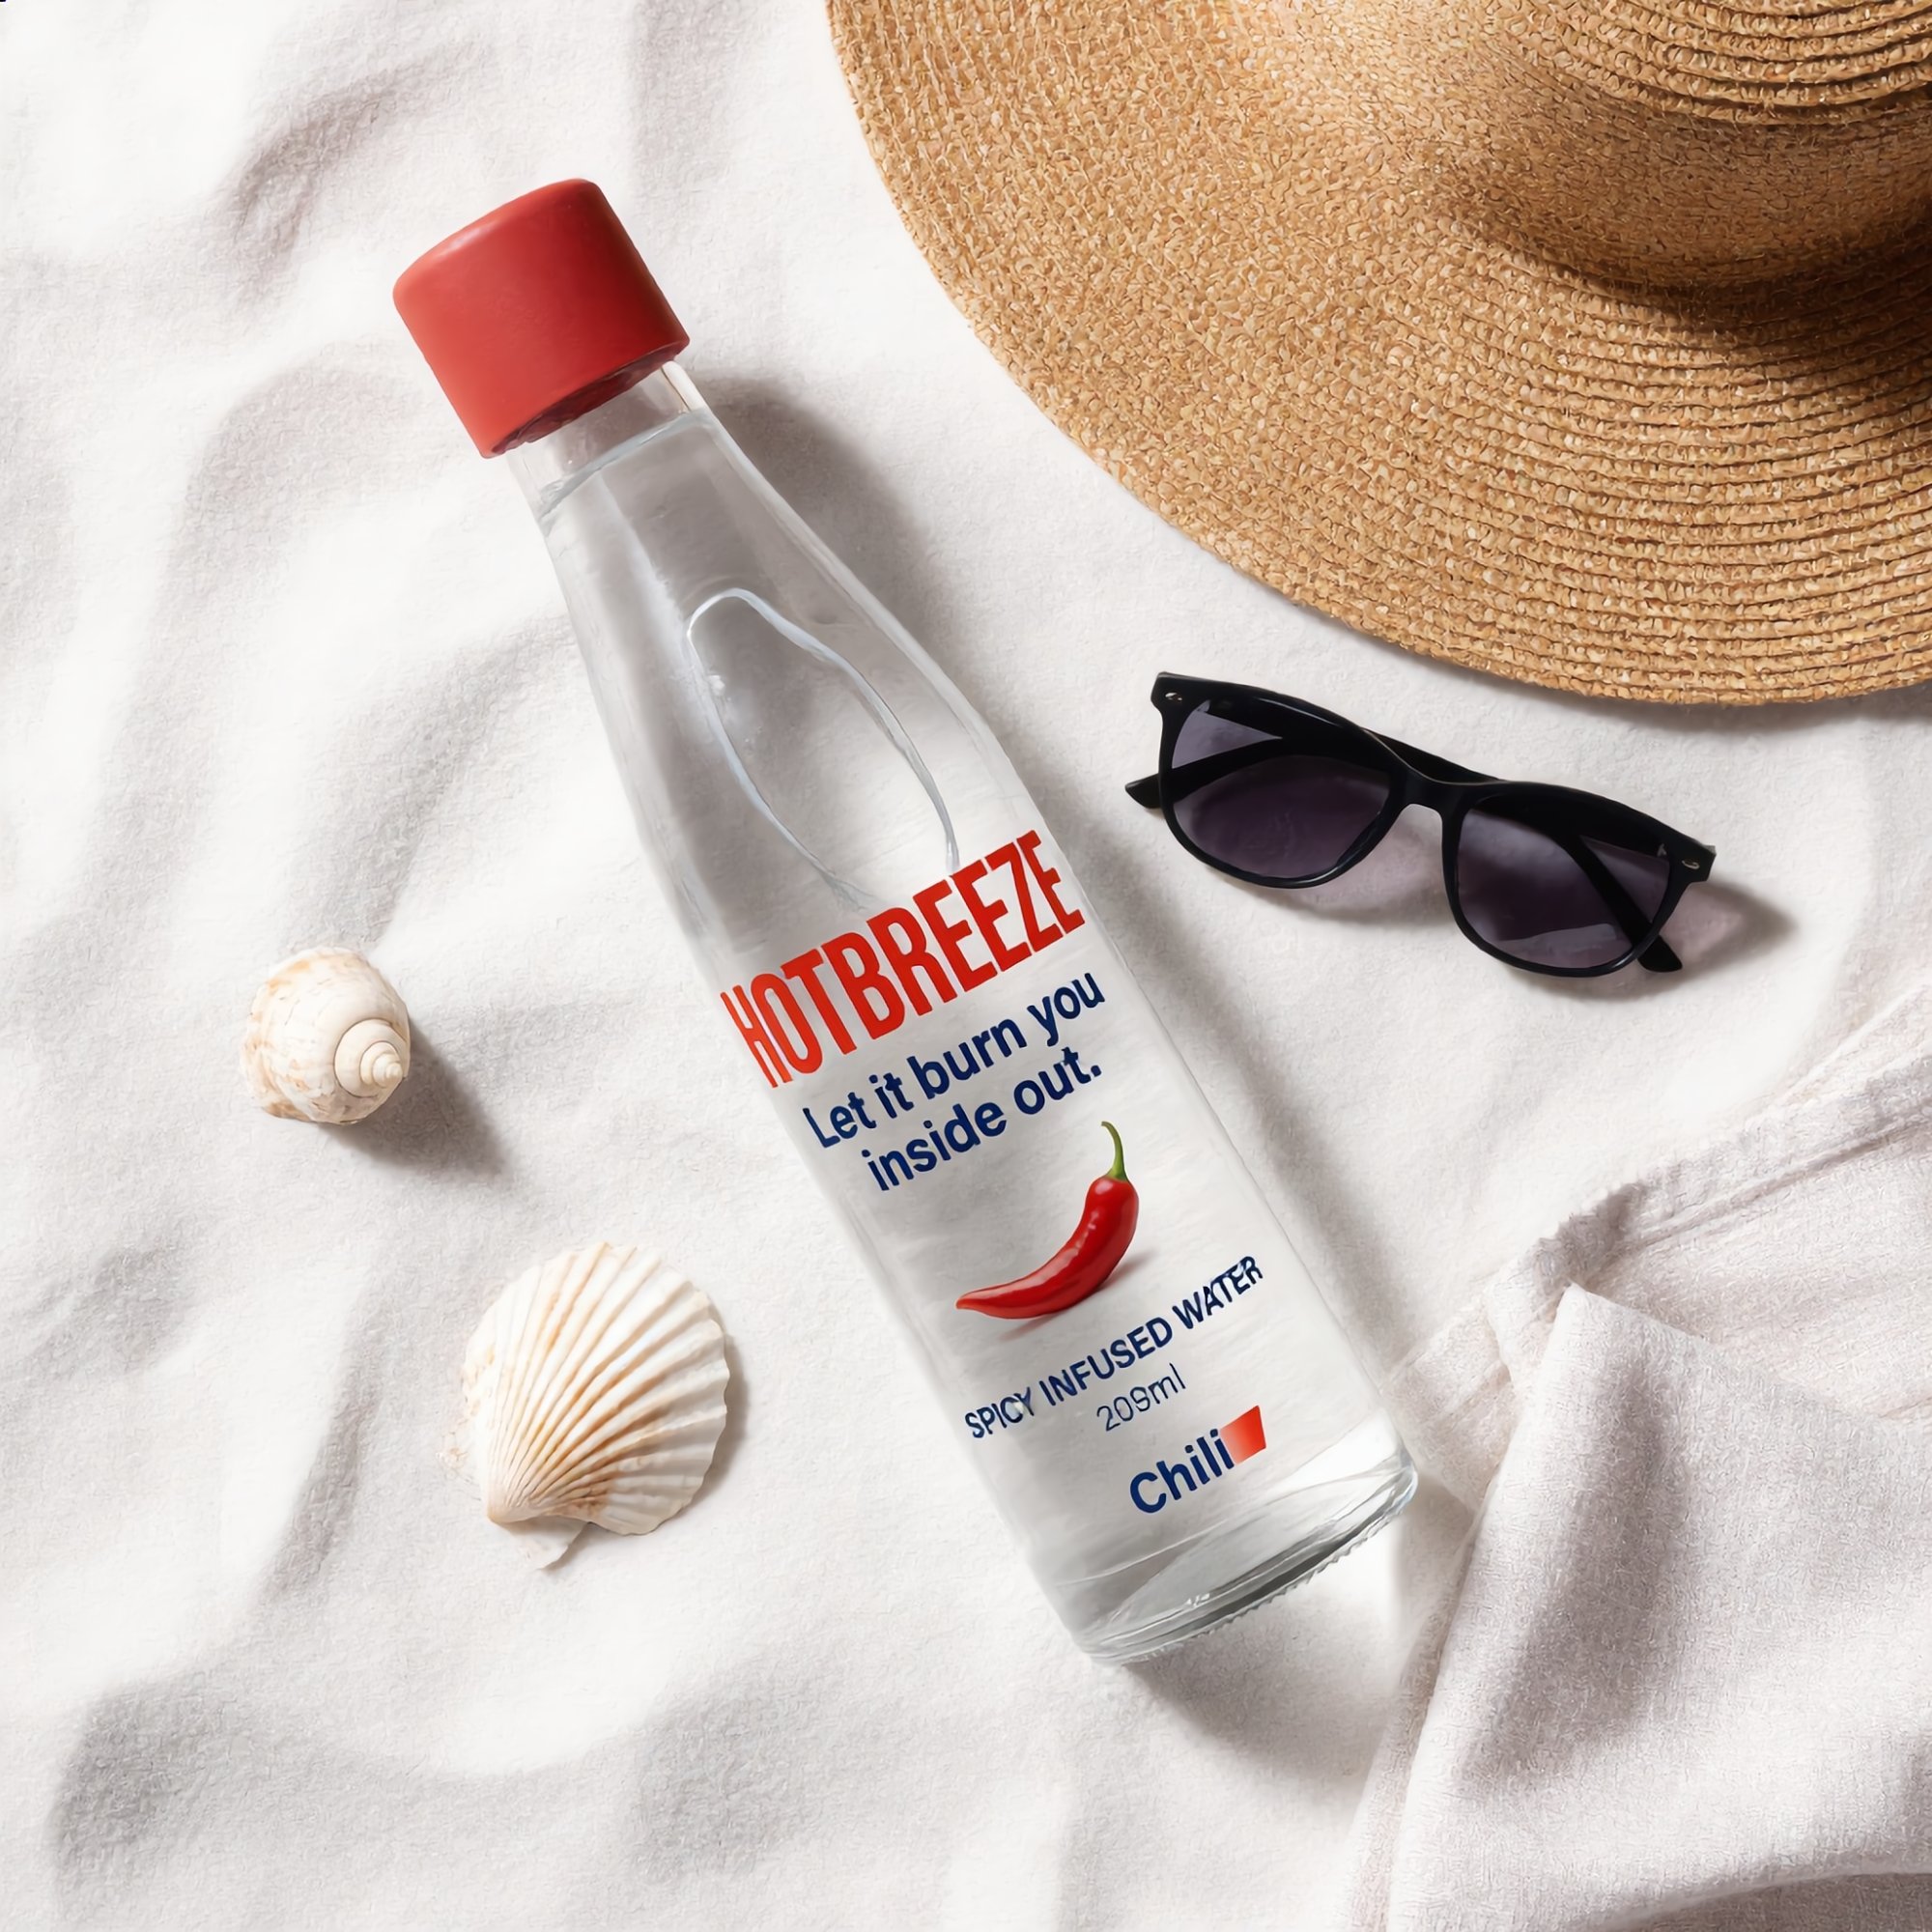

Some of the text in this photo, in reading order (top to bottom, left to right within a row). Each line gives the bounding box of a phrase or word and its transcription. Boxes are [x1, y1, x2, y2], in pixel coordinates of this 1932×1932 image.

[720, 830, 1086, 1089] HOTBREEZE
[802, 972, 1106, 1150] Let it burn you
[861, 1046, 1103, 1192] inside out.
[964, 1255, 1264, 1439] SPICY INFUSED WATER
[1095, 1361, 1187, 1433] 209ml
[1128, 1428, 1236, 1515] Chili
